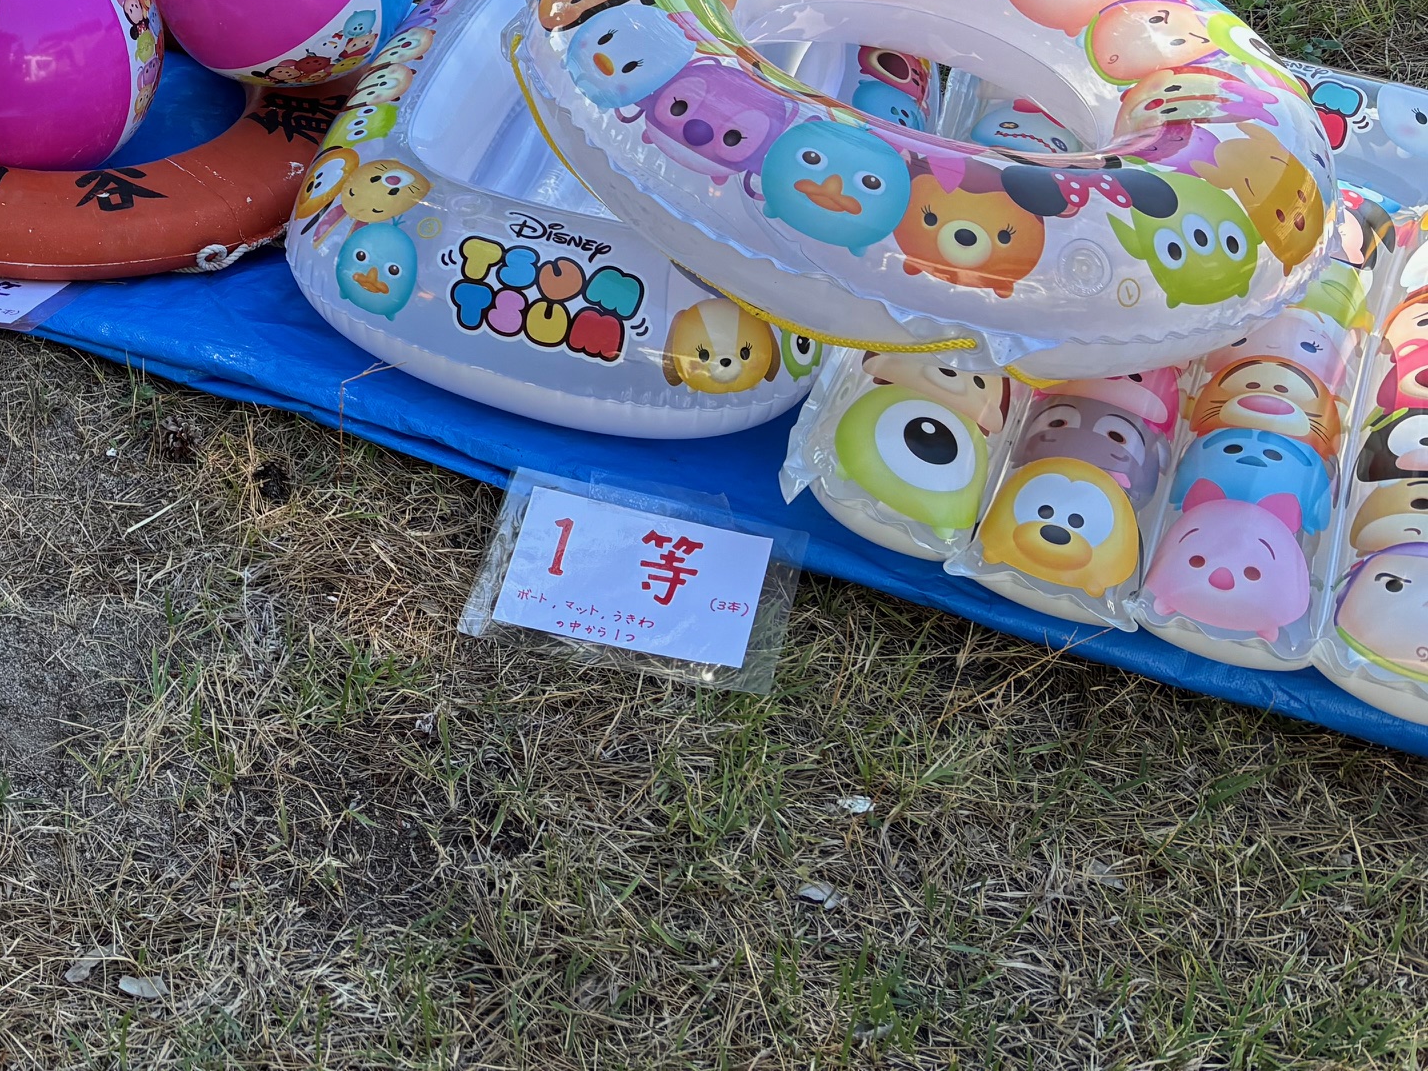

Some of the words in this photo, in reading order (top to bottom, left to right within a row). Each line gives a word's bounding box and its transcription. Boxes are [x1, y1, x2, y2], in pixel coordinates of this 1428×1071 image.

[508, 210, 612, 263] Disney
[458, 235, 645, 320] TSUM
[450, 279, 625, 362] TSUM
[709, 595, 750, 619] (3本)
